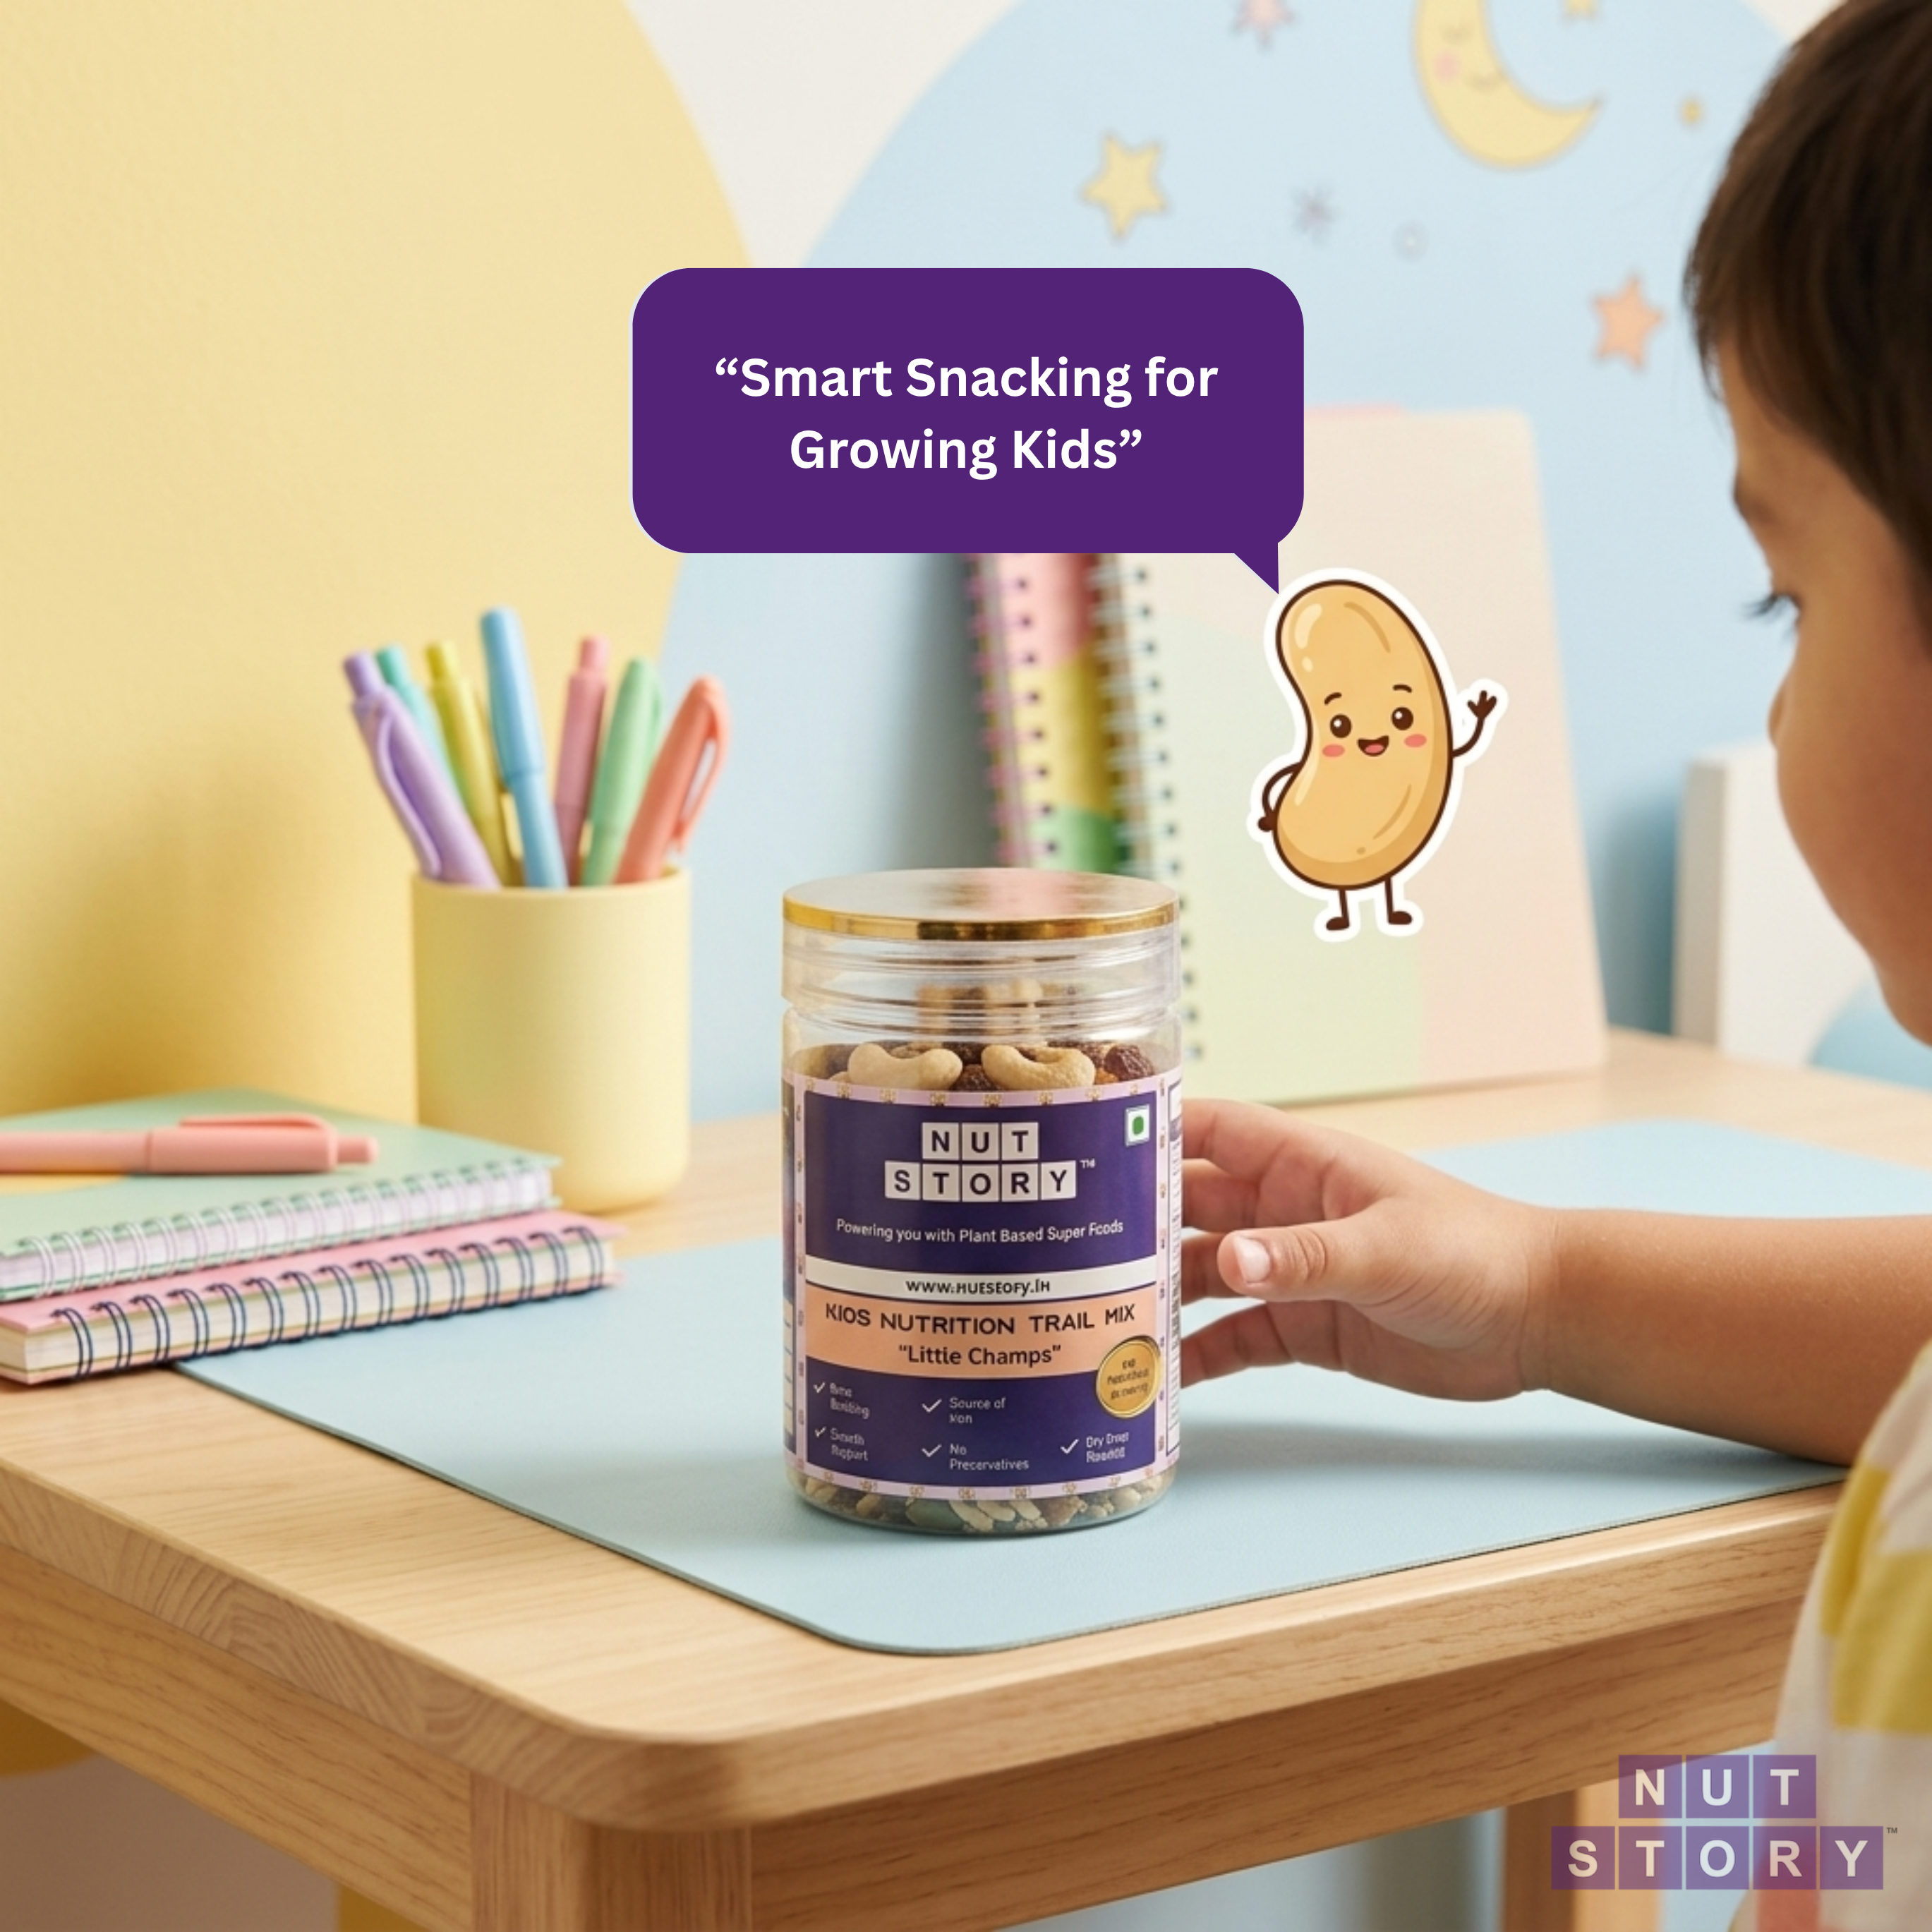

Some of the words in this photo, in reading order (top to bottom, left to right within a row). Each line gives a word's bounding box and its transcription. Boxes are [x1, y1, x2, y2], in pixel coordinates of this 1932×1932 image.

[893, 1169, 1068, 1196] STORY
[836, 1218, 893, 1242] Powering
[896, 1228, 922, 1243] you
[924, 1228, 955, 1243] with
[959, 1228, 997, 1243] Plant
[999, 1226, 1044, 1243] Based
[1046, 1226, 1086, 1243] Super
[880, 1312, 1015, 1336] NUTRITION
[1028, 1311, 1095, 1334] TRAIL
[1104, 1303, 1135, 1326] MIX
